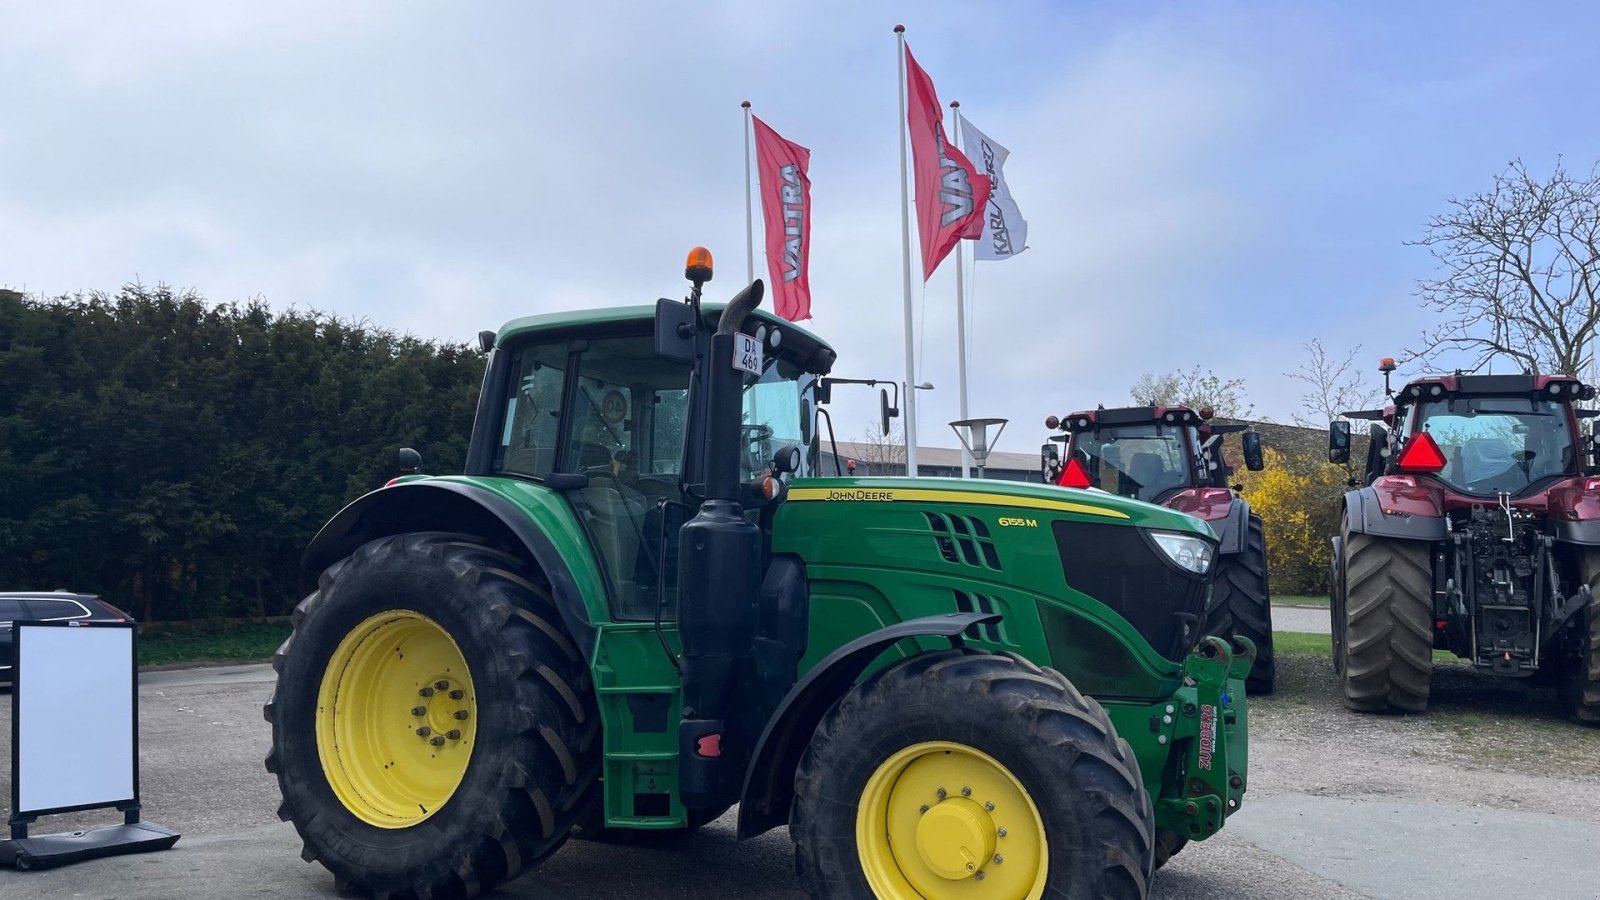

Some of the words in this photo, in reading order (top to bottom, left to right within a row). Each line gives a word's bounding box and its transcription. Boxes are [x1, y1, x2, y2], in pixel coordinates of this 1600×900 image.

[779, 163, 804, 283] VALTRA
[990, 209, 1010, 255] KARL
[742, 353, 758, 371] 469
[744, 338, 757, 356] DA
[825, 490, 855, 500] JOHN
[856, 490, 893, 500] DEERE
[1199, 704, 1213, 771] ZUIDBERG
